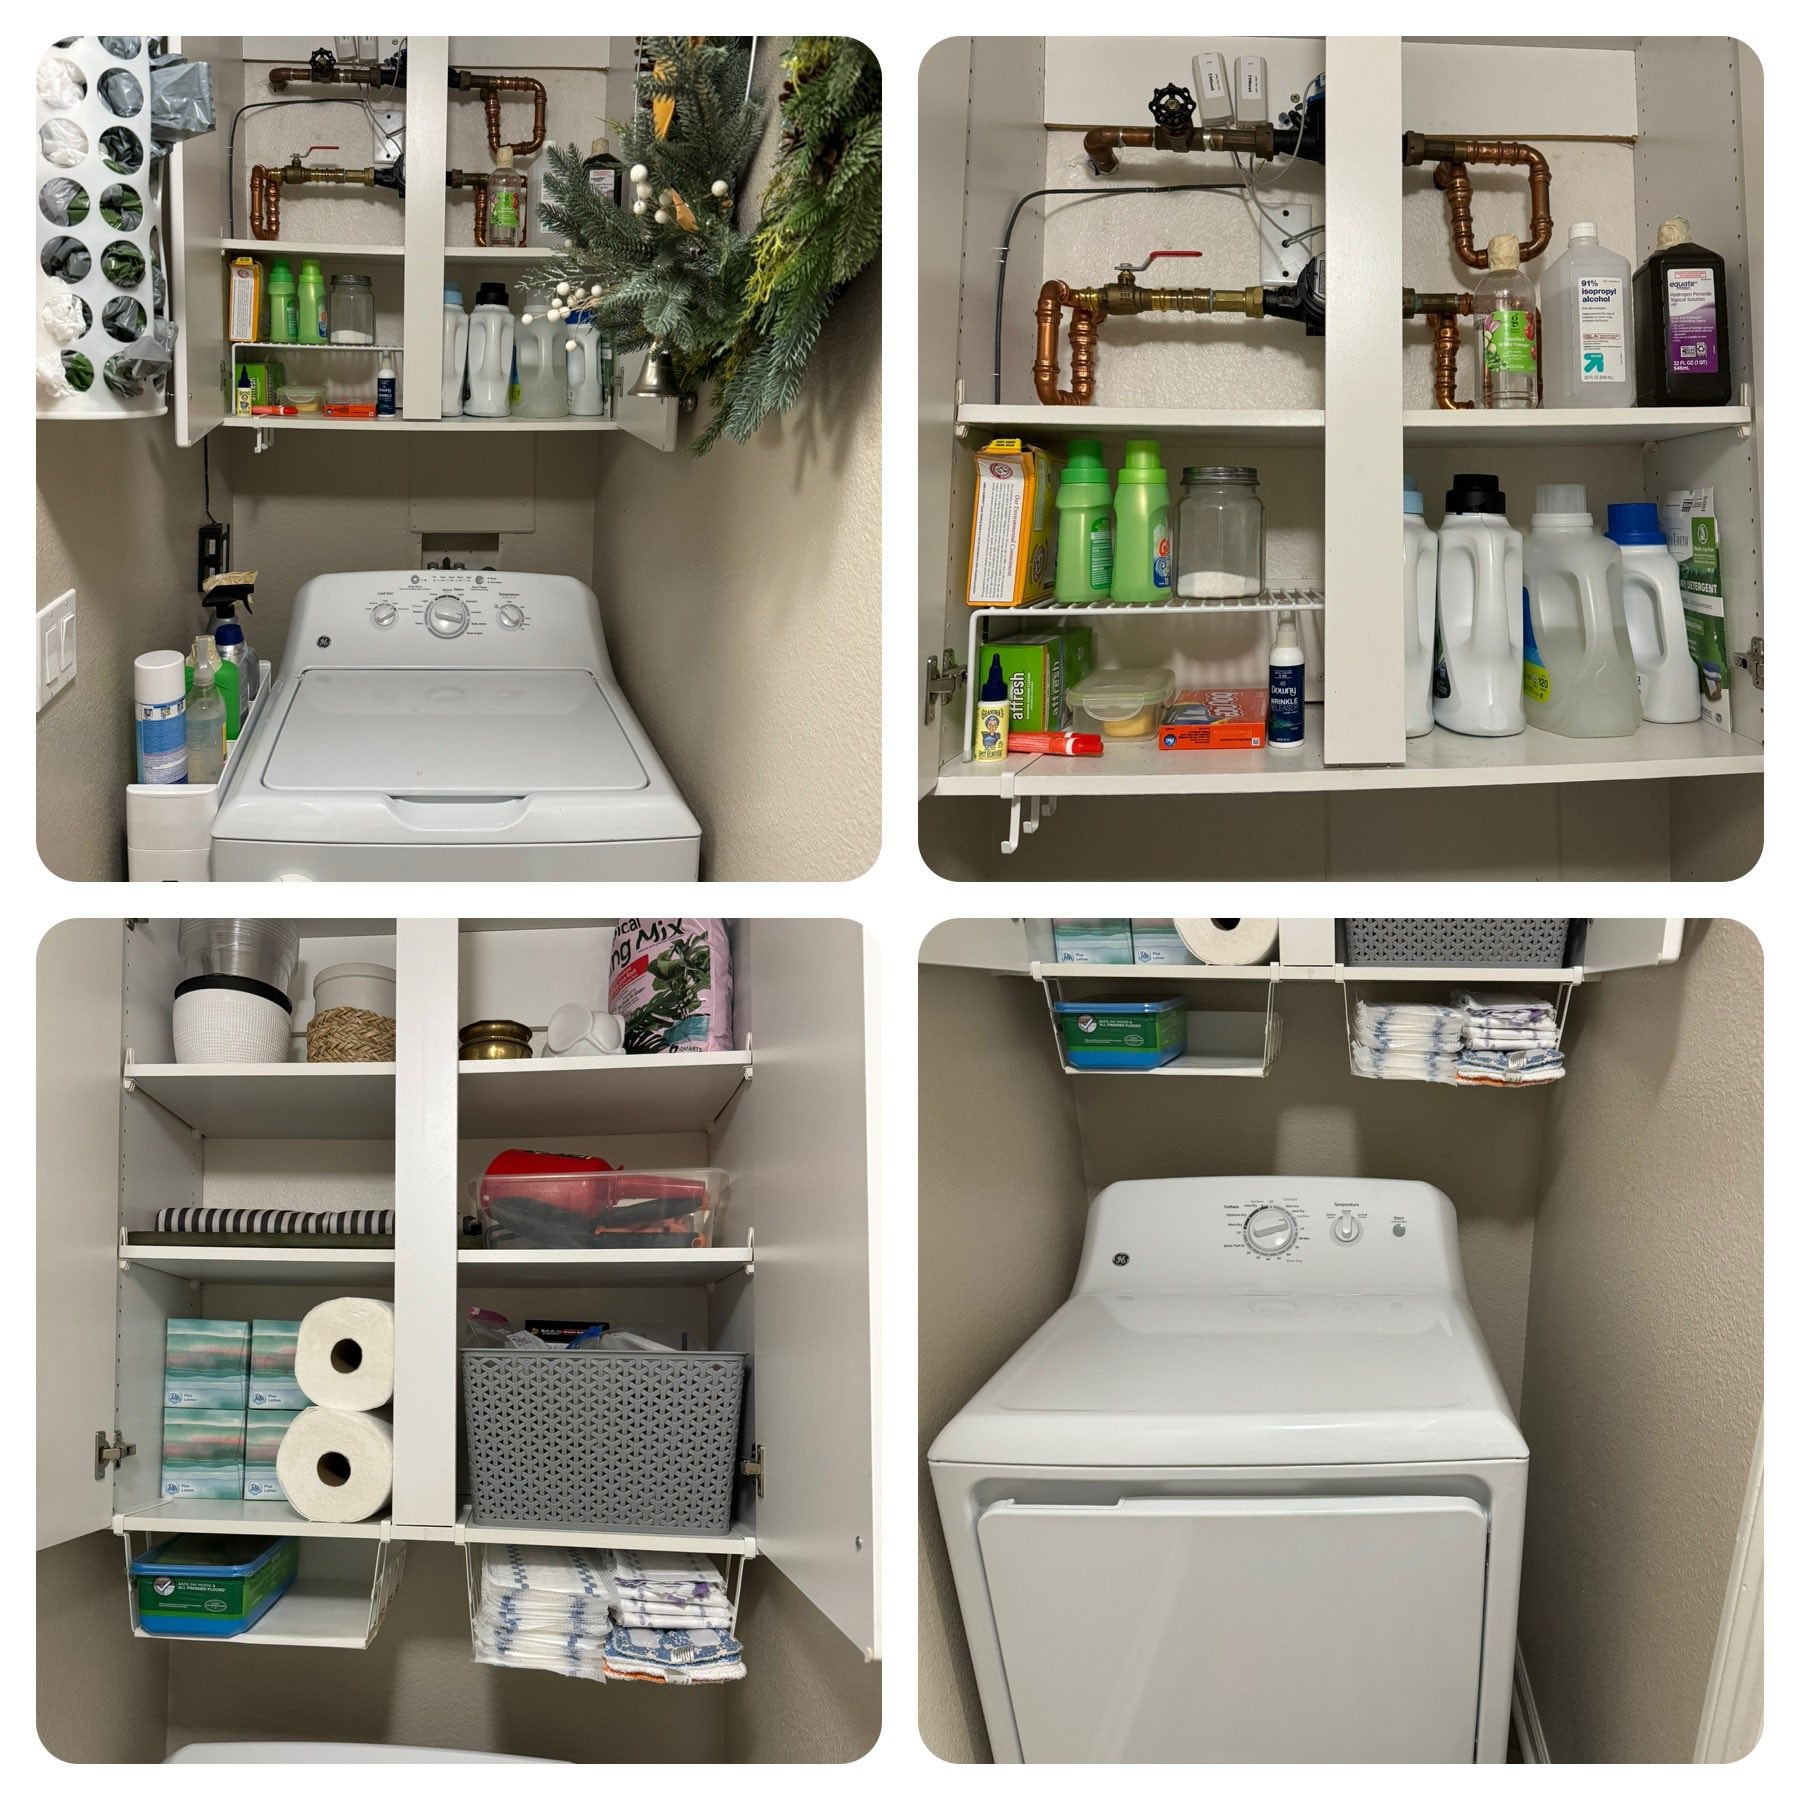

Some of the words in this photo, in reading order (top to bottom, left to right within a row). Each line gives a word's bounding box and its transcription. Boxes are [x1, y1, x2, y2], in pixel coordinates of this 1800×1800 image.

[1582, 288, 1616, 296] isopropyl
[1011, 506, 1019, 543] Environmental
[1008, 544, 1016, 576] Commitment
[1687, 581, 1718, 593] DETERGENT
[1010, 672, 1024, 720] affresh
[1208, 692, 1240, 716] bounce
[1272, 686, 1296, 696] Downy
[636, 918, 685, 950] Mix
